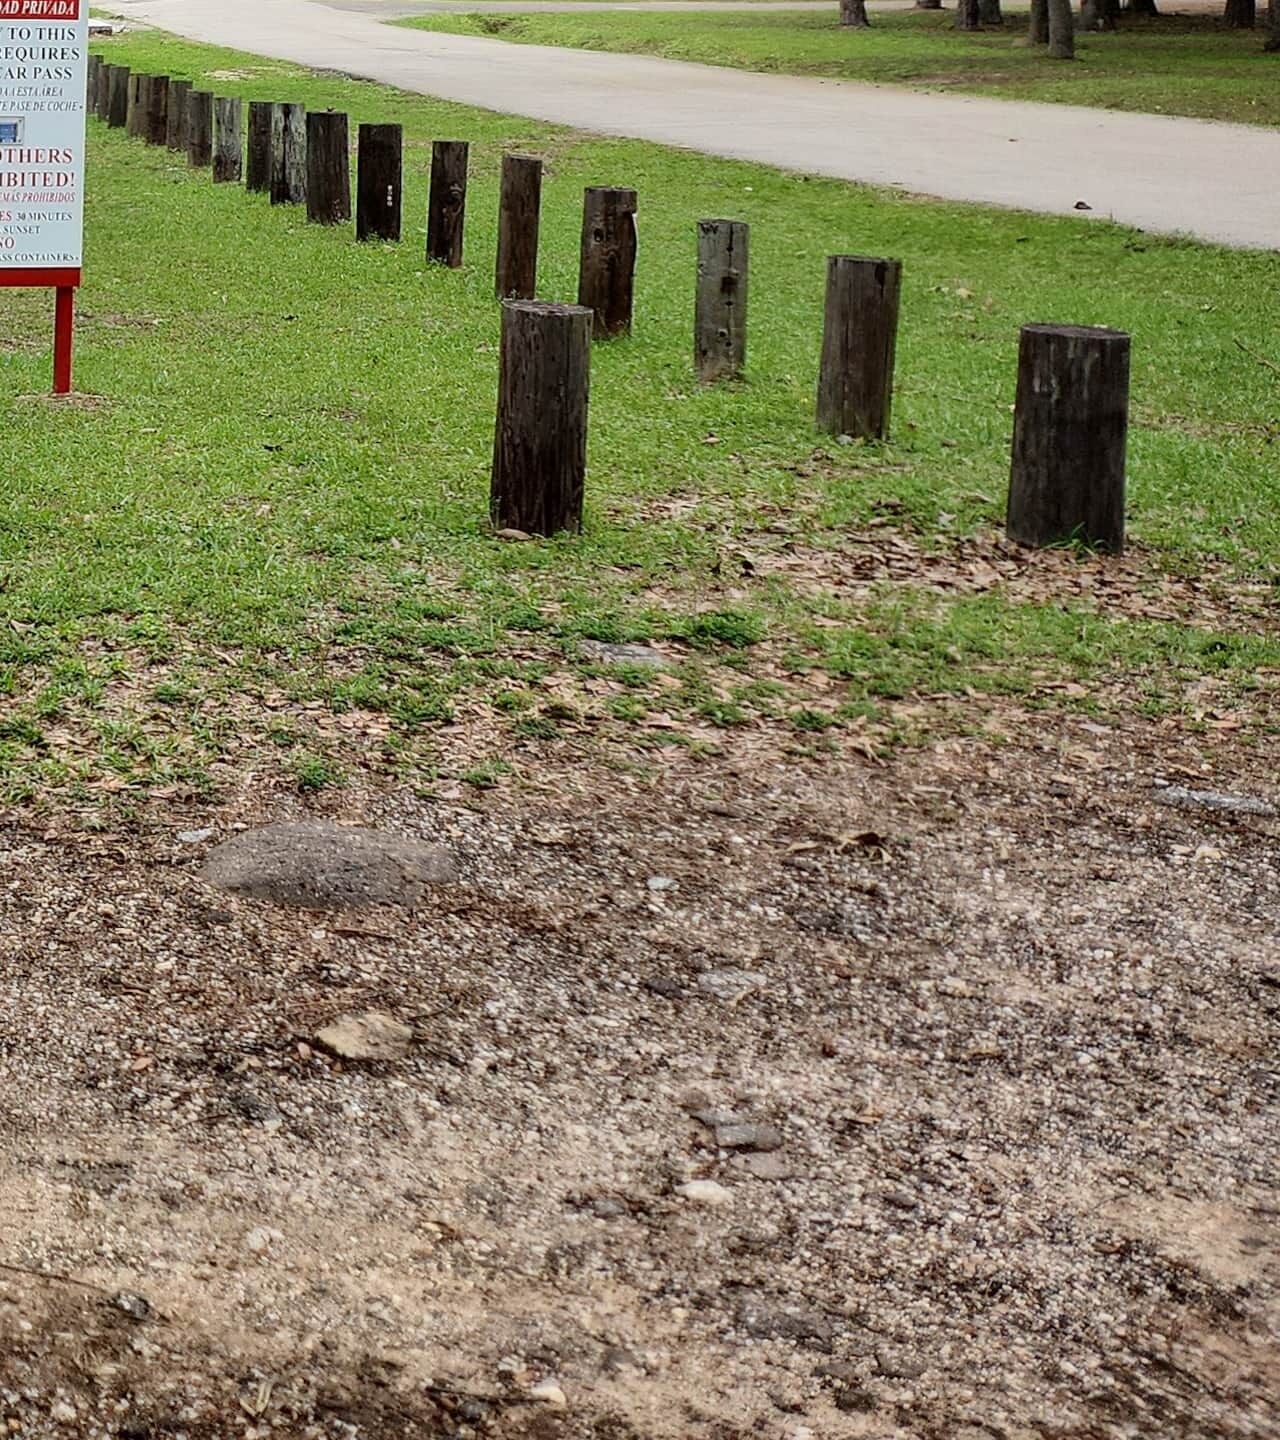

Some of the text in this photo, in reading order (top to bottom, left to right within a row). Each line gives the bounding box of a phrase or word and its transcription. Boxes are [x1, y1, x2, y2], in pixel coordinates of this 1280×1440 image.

[22, 1, 74, 15] PRIVADA
[7, 27, 31, 40] TO
[36, 28, 76, 40] THIS
[33, 67, 72, 79] PASS
[33, 101, 45, 111] DE
[47, 101, 78, 111] COCHE
[22, 192, 76, 202] PROHIBIDOS
[16, 213, 26, 221] 30
[29, 213, 72, 221] MINUTES
[4, 226, 40, 234] SUNSET
[15, 253, 74, 262] CONTAINERS
